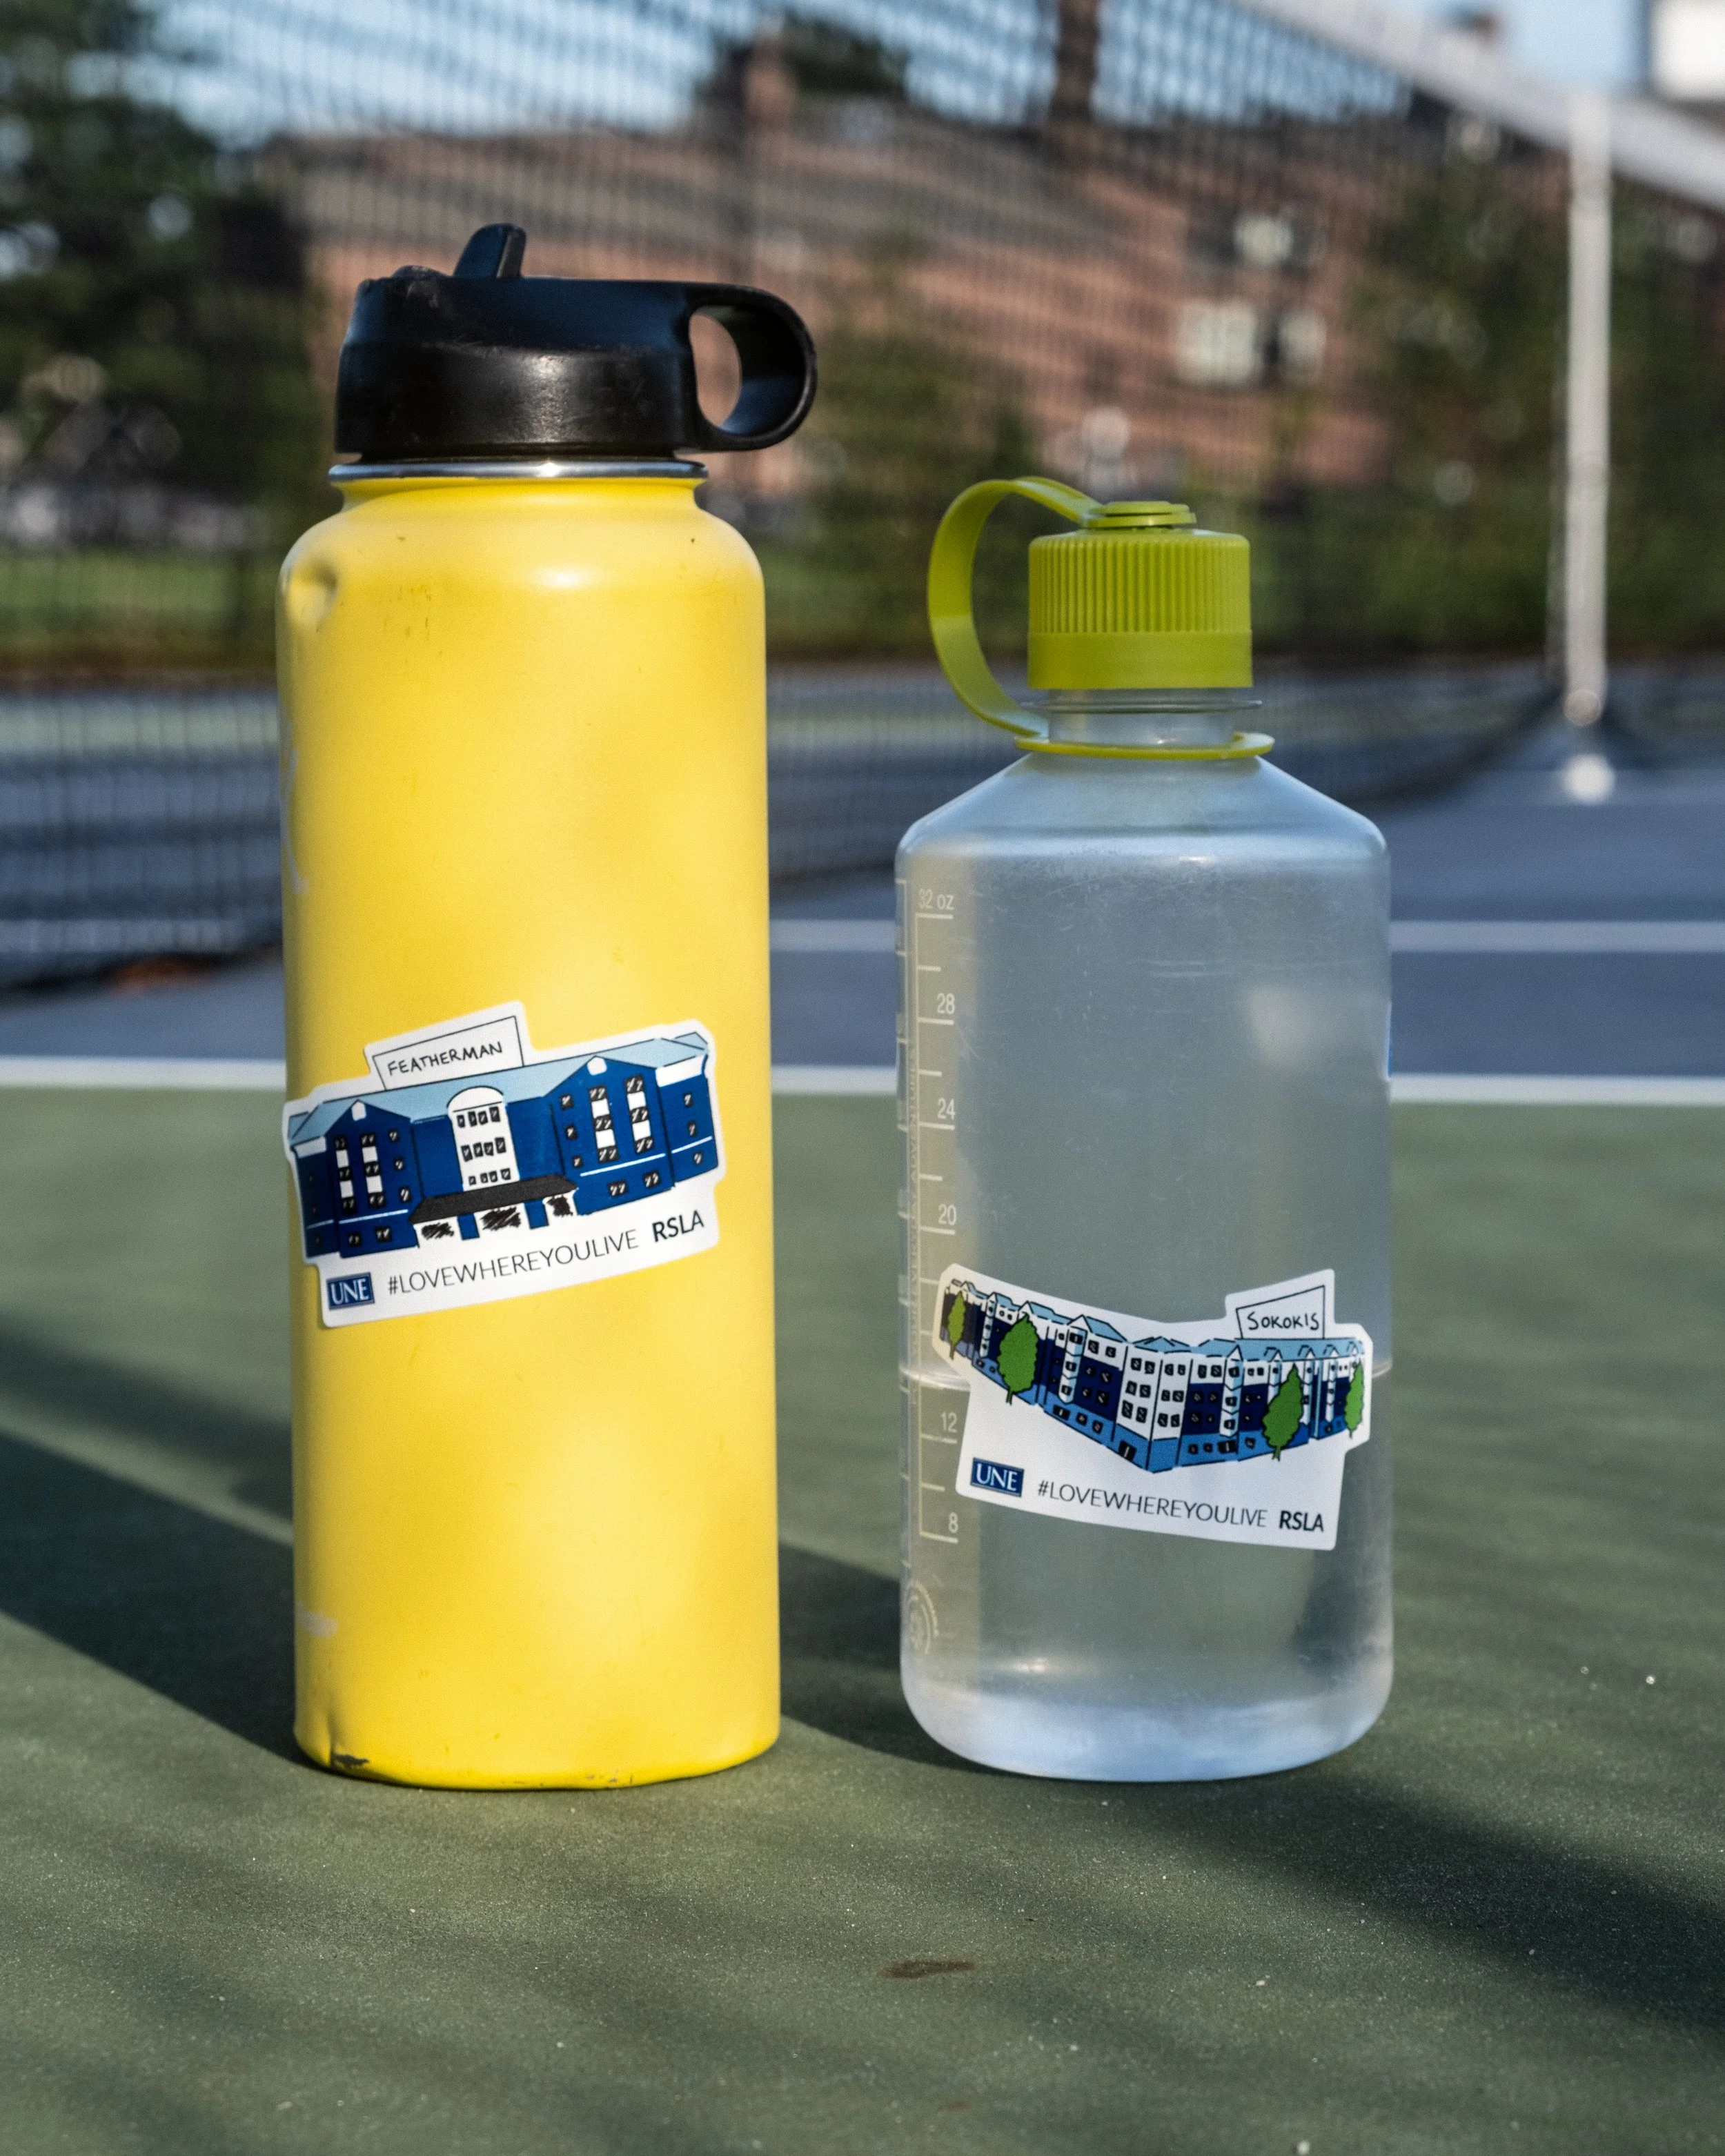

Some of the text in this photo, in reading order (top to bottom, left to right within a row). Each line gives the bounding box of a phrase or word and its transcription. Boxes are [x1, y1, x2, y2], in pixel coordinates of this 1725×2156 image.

[918, 888, 934, 909] 32
[936, 992, 955, 1014] 28
[387, 1041, 502, 1076] FEATHERMAN
[937, 1098, 955, 1120] 24
[938, 1204, 956, 1226] 20
[388, 1209, 704, 1295] #LOVEWHEREYOULIVE RSLA
[331, 1278, 370, 1305] UNE
[940, 1411, 957, 1433] 12
[976, 1465, 1018, 1492] UNE
[1038, 1481, 1324, 1532] #LOVEWHEREYOULIVE RSLA
[948, 1512, 958, 1532] 8
